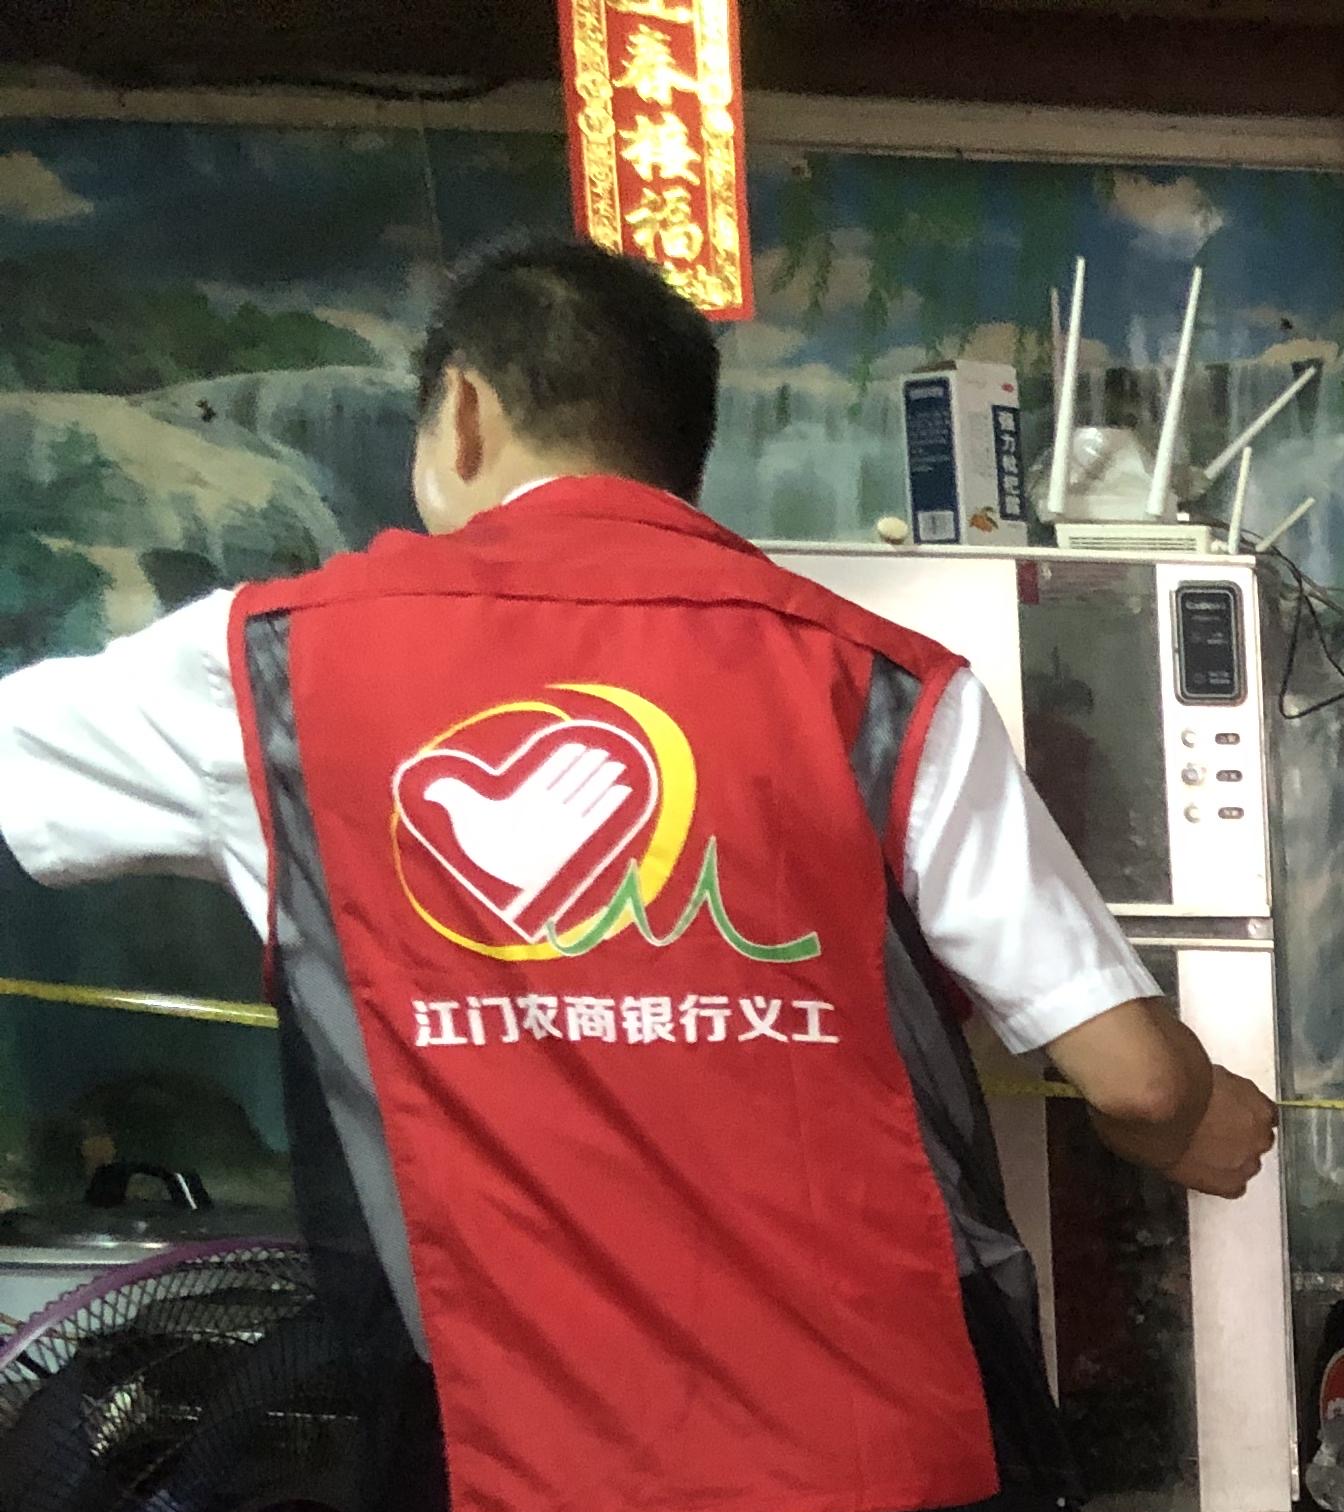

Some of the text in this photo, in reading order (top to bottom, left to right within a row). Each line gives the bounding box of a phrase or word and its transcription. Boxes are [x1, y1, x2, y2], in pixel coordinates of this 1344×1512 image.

[608, 0, 702, 262] 春接福
[413, 995, 841, 1048] 江门农商银行义工
